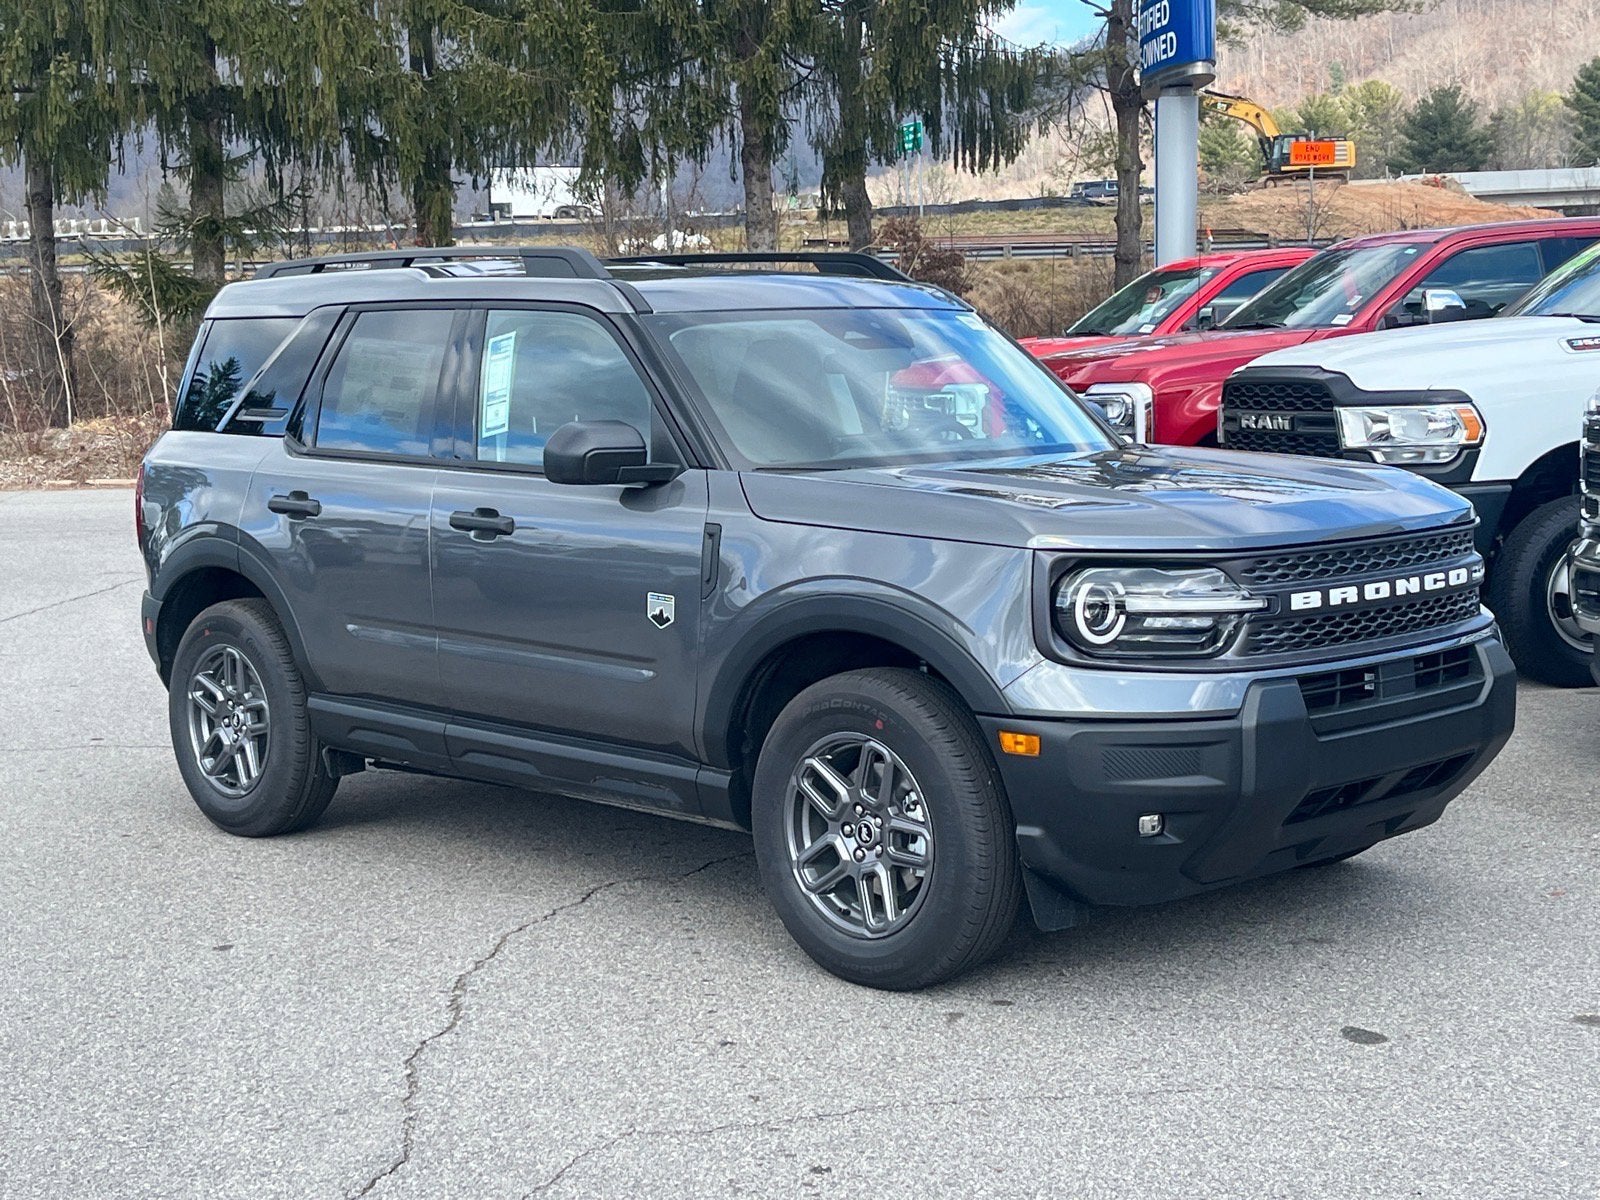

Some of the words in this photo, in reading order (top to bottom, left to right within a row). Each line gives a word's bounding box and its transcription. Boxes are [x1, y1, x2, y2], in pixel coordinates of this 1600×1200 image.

[1305, 144, 1320, 153] END
[1240, 414, 1291, 431] RAM
[1290, 567, 1468, 611] BRONCO
